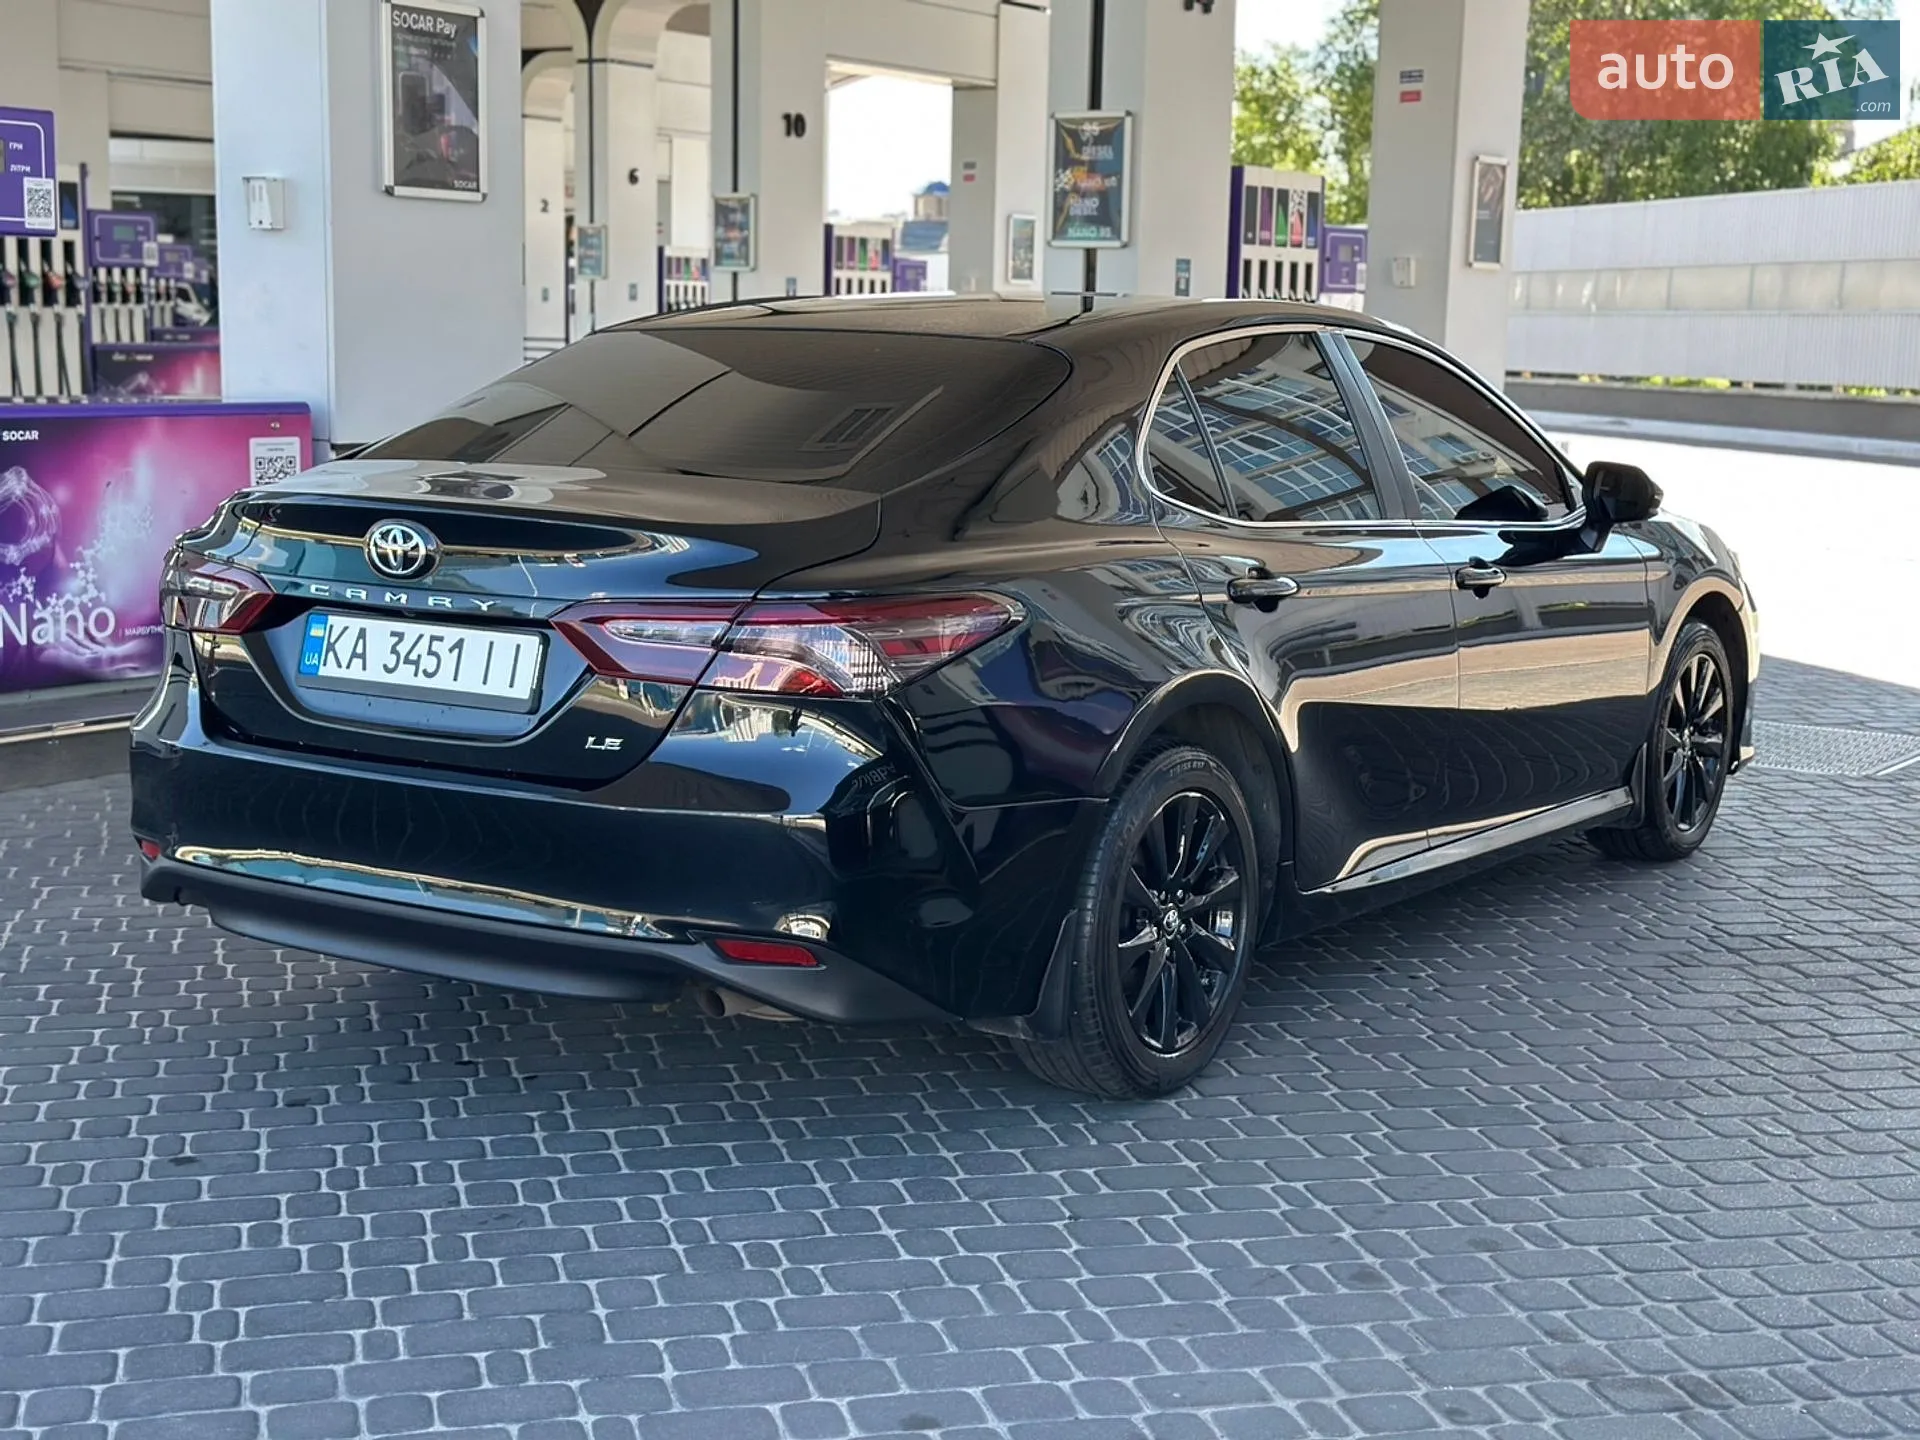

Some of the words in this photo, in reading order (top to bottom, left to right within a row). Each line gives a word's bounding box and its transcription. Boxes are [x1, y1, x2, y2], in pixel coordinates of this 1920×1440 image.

[392, 10, 434, 33] SOCAR
[435, 17, 457, 39] Pay
[781, 112, 807, 139] 10
[453, 179, 479, 190] SOCAR
[628, 167, 640, 186] 6
[540, 199, 550, 213] 2
[2, 430, 40, 441] SOCAR
[309, 583, 501, 612] CAMRY
[0, 601, 116, 648] Nano
[304, 652, 319, 666] UA
[322, 623, 368, 672] KA
[382, 629, 466, 683] 3451
[584, 736, 625, 751] LE
